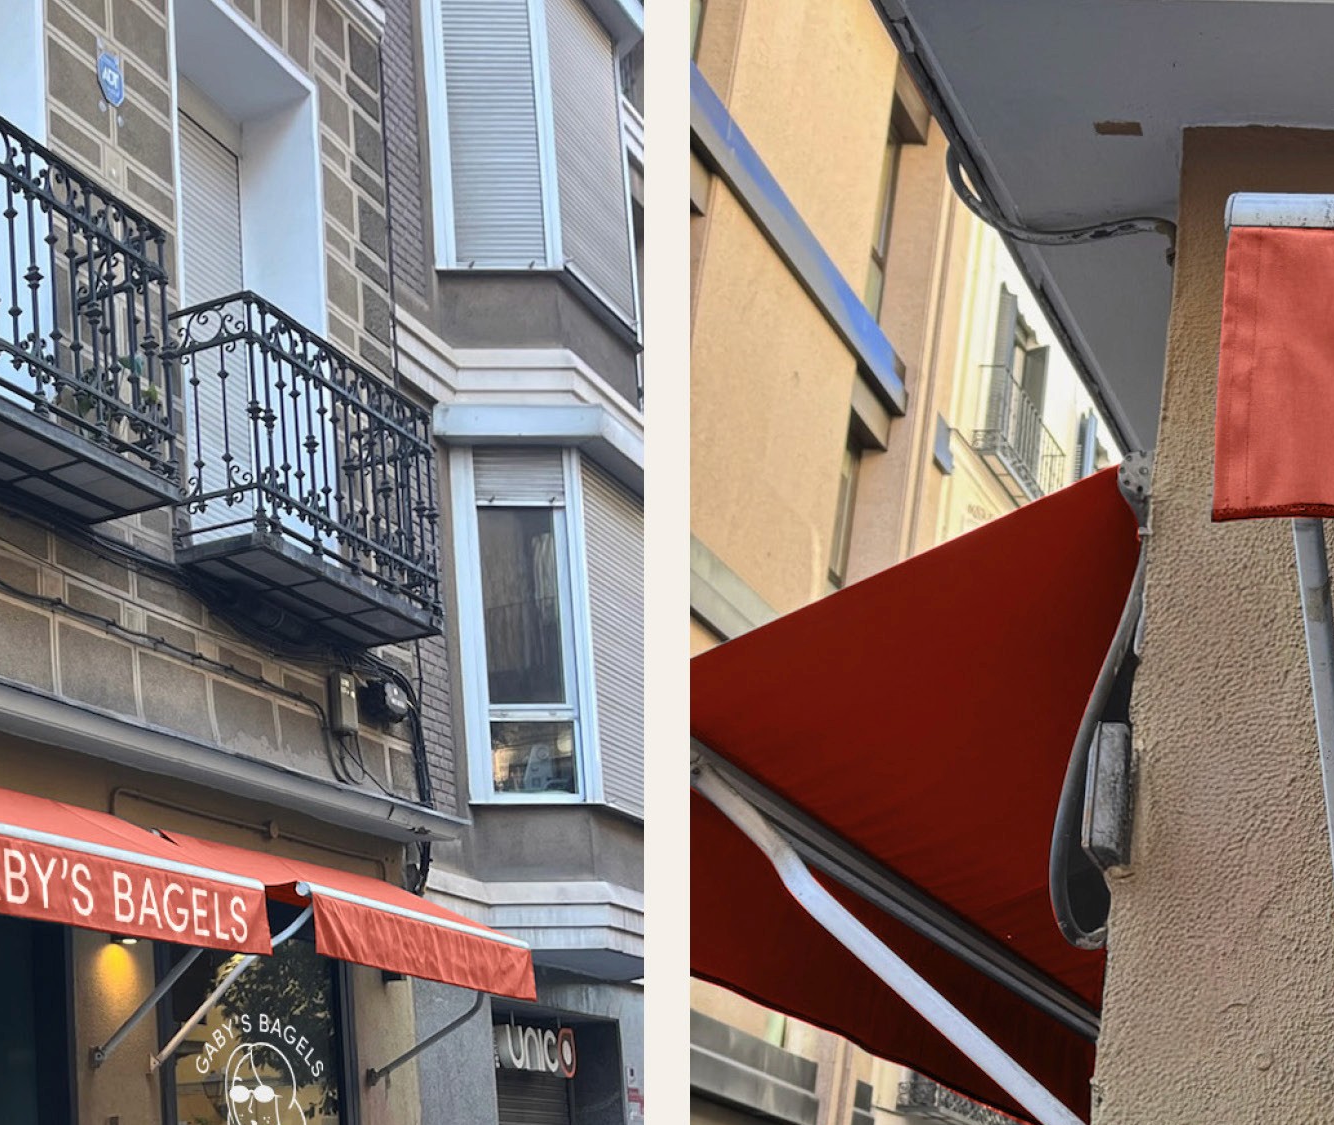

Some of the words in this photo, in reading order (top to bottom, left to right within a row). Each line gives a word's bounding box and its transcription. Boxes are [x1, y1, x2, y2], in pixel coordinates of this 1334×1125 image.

[112, 870, 249, 944] BAGELS
[195, 1013, 253, 1075] GABY'S
[259, 1013, 325, 1078] BAGELS
